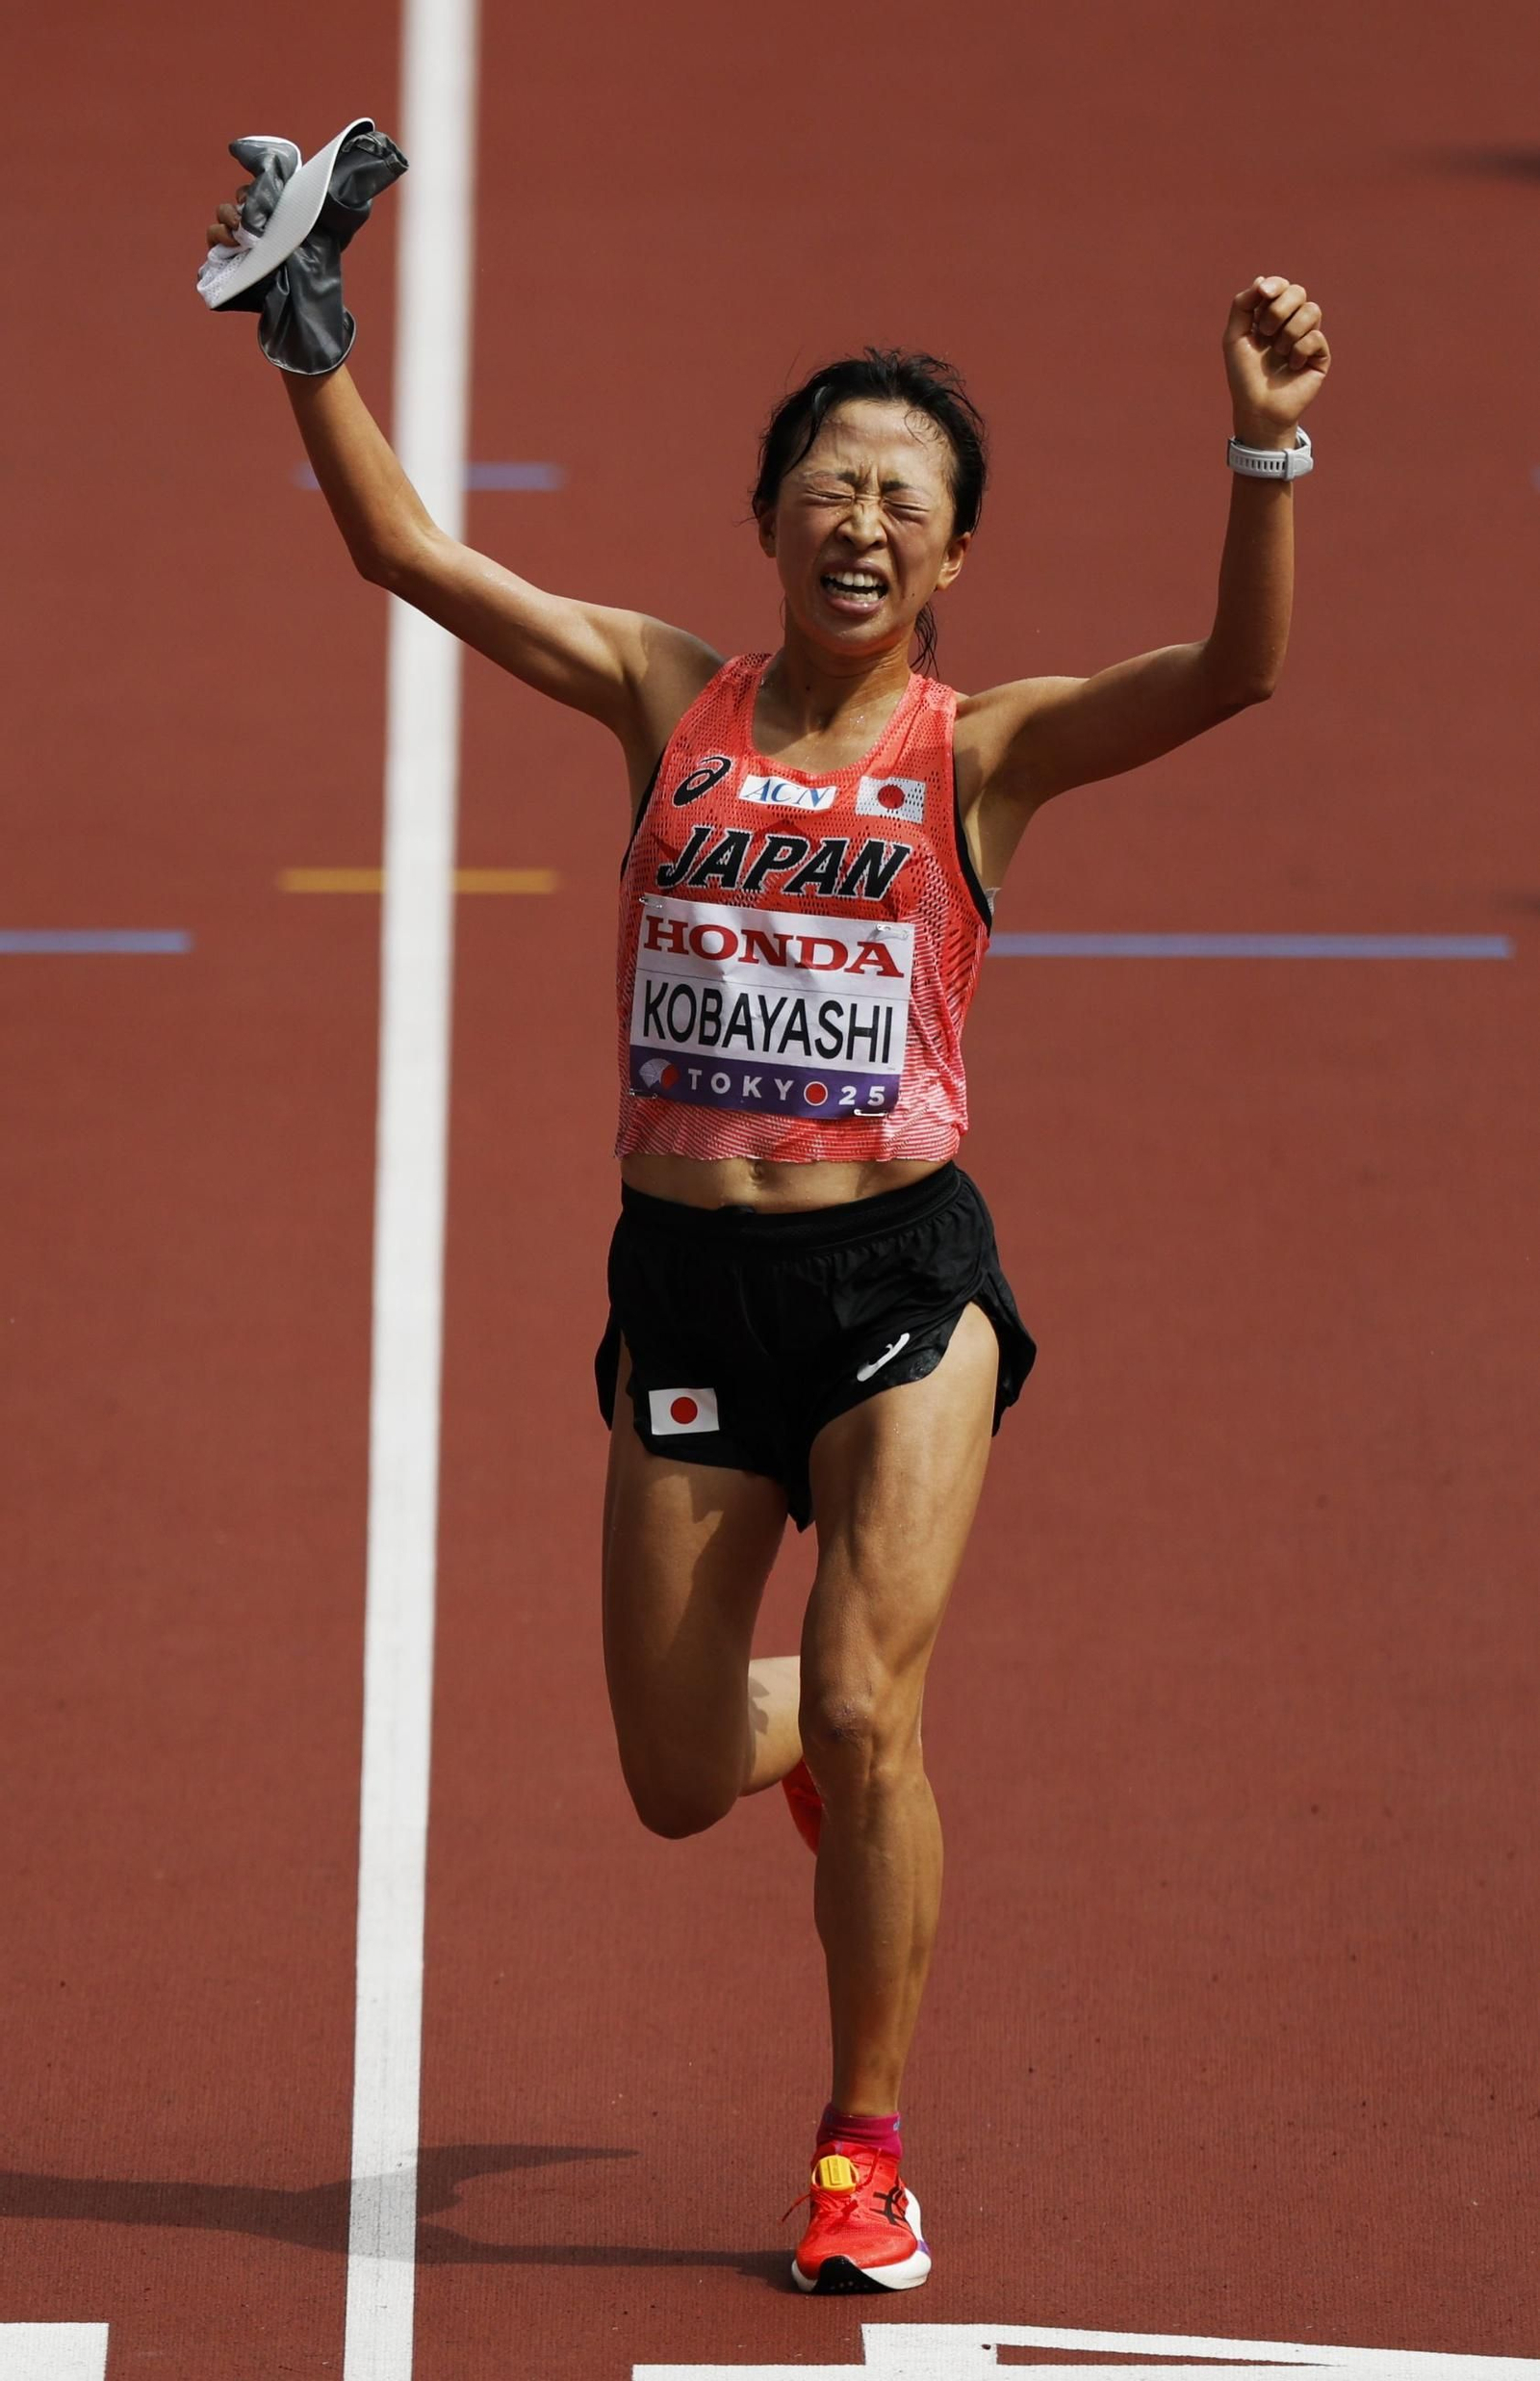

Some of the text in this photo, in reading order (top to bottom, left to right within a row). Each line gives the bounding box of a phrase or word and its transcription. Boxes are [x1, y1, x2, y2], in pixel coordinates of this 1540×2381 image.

[743, 778, 830, 808] ACN
[656, 825, 912, 899] JAPAN
[643, 916, 905, 978] HONDA
[643, 980, 894, 1063] KOBAYASHI
[838, 1085, 885, 1106] 25
